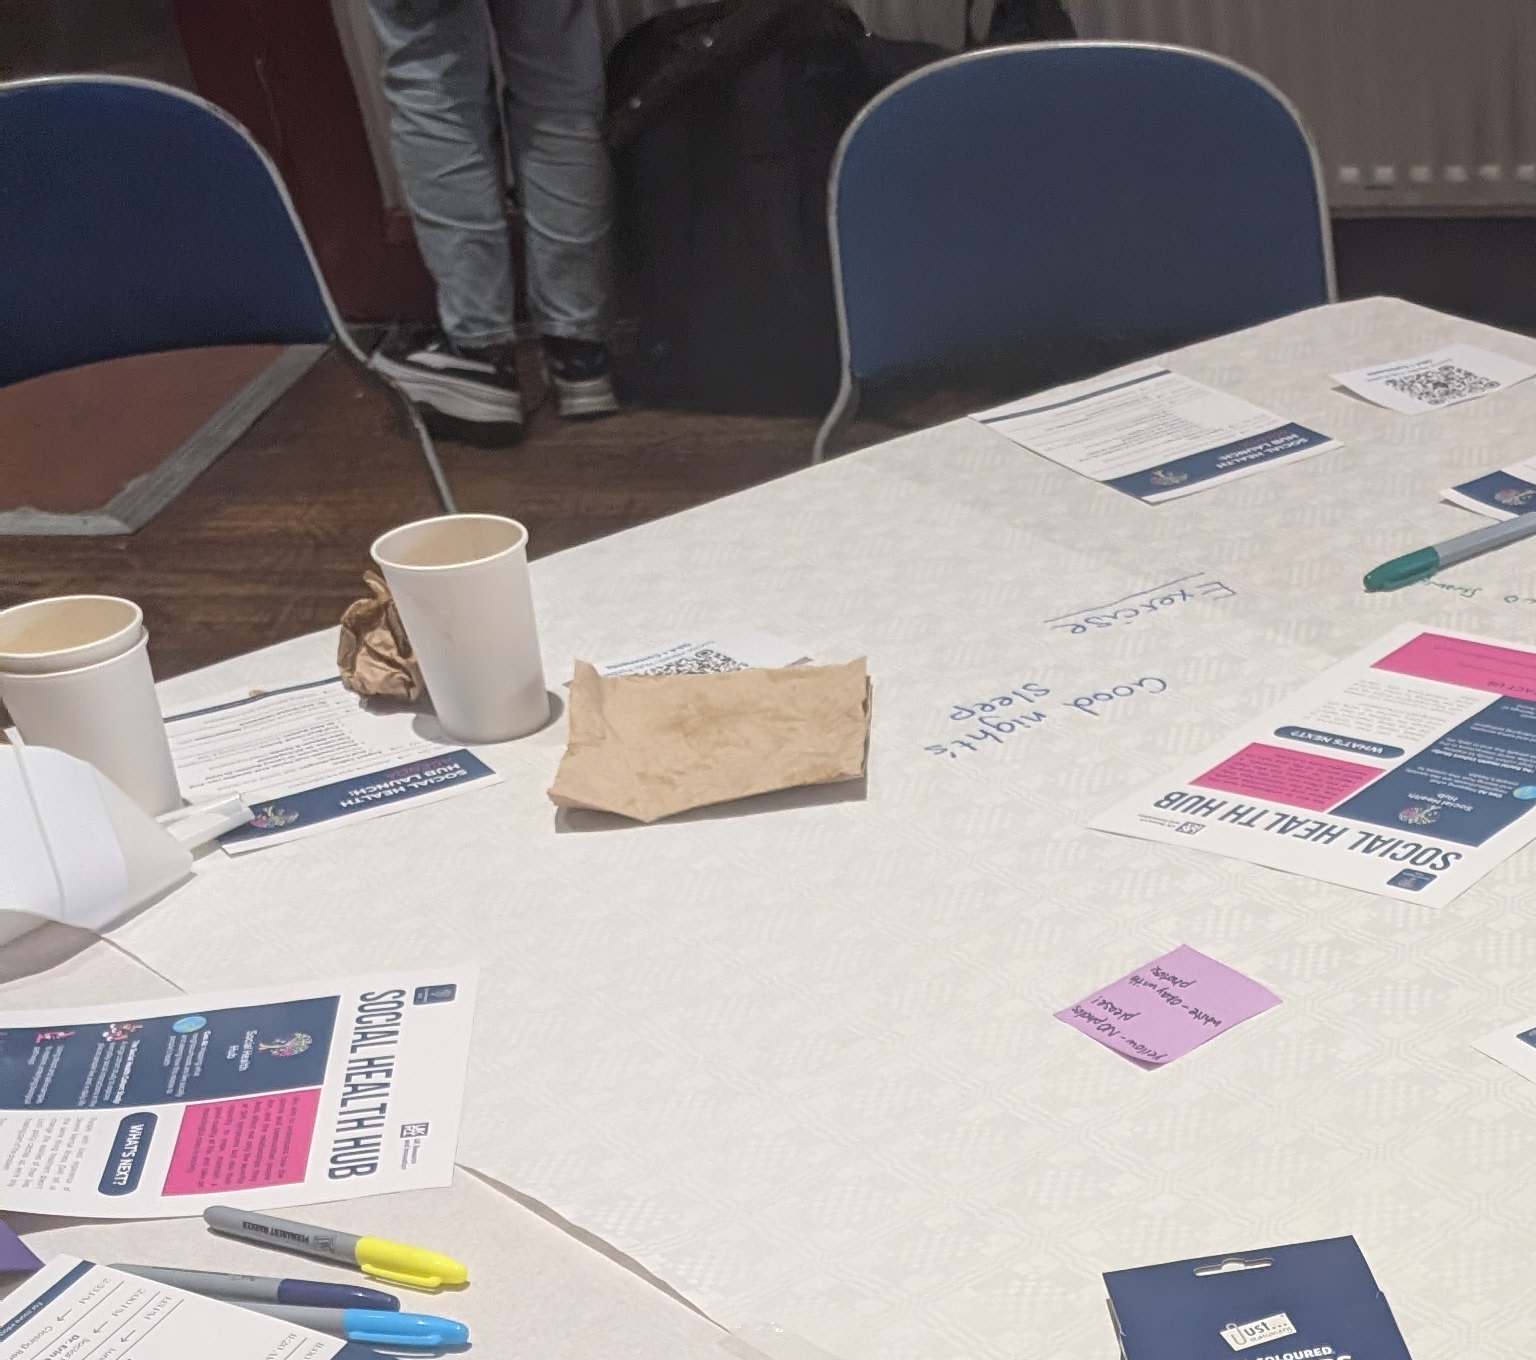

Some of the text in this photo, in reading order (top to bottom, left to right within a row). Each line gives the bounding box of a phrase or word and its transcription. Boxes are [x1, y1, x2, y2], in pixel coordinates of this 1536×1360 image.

[1063, 677, 1167, 716] Good
[1290, 730, 1383, 753] WHAT'S NEXT?
[341, 769, 467, 807] SOCIAL HEALTH
[425, 763, 460, 777] HUB
[1153, 791, 1462, 871] SOCIAL HEALTH HUB
[328, 989, 406, 1180] SOCIAL HEALTH HUB
[112, 1124, 144, 1185] WHAT'S NEXT?
